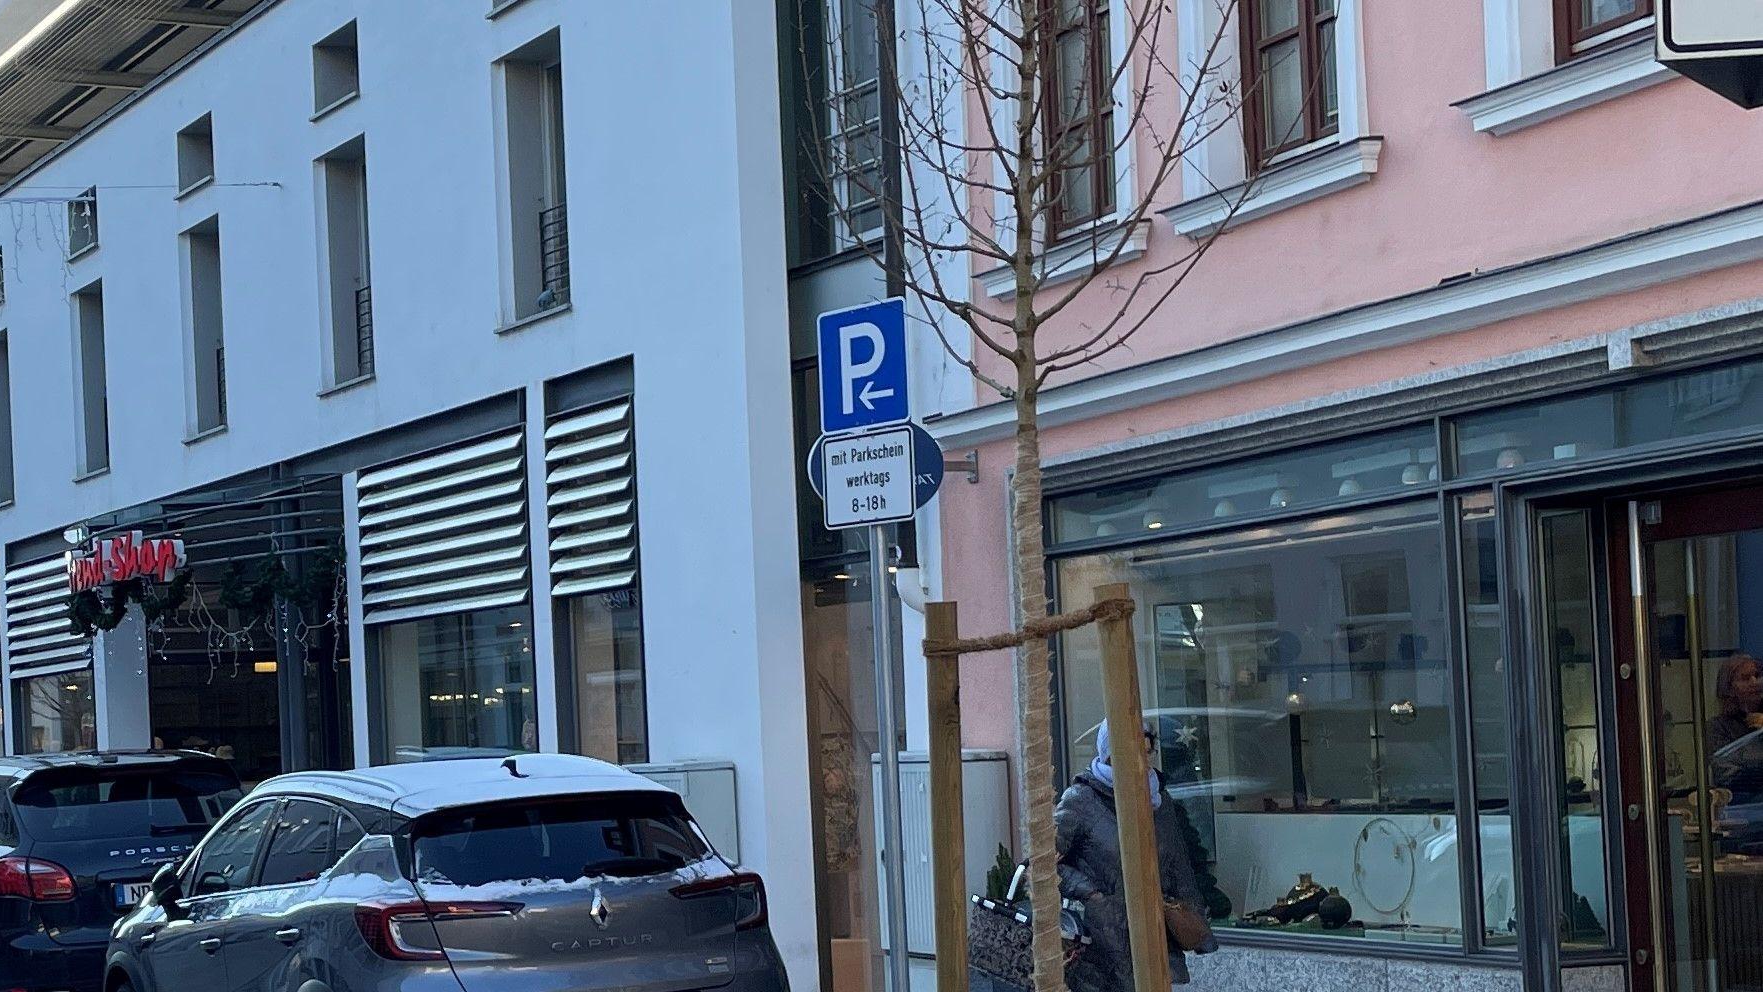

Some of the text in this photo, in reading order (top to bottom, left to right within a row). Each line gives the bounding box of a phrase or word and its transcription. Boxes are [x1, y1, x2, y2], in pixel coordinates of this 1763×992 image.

[839, 321, 885, 415] P
[831, 442, 904, 466] mit Parkschein
[846, 470, 891, 488] werktags
[551, 933, 654, 951] CAPTUR
